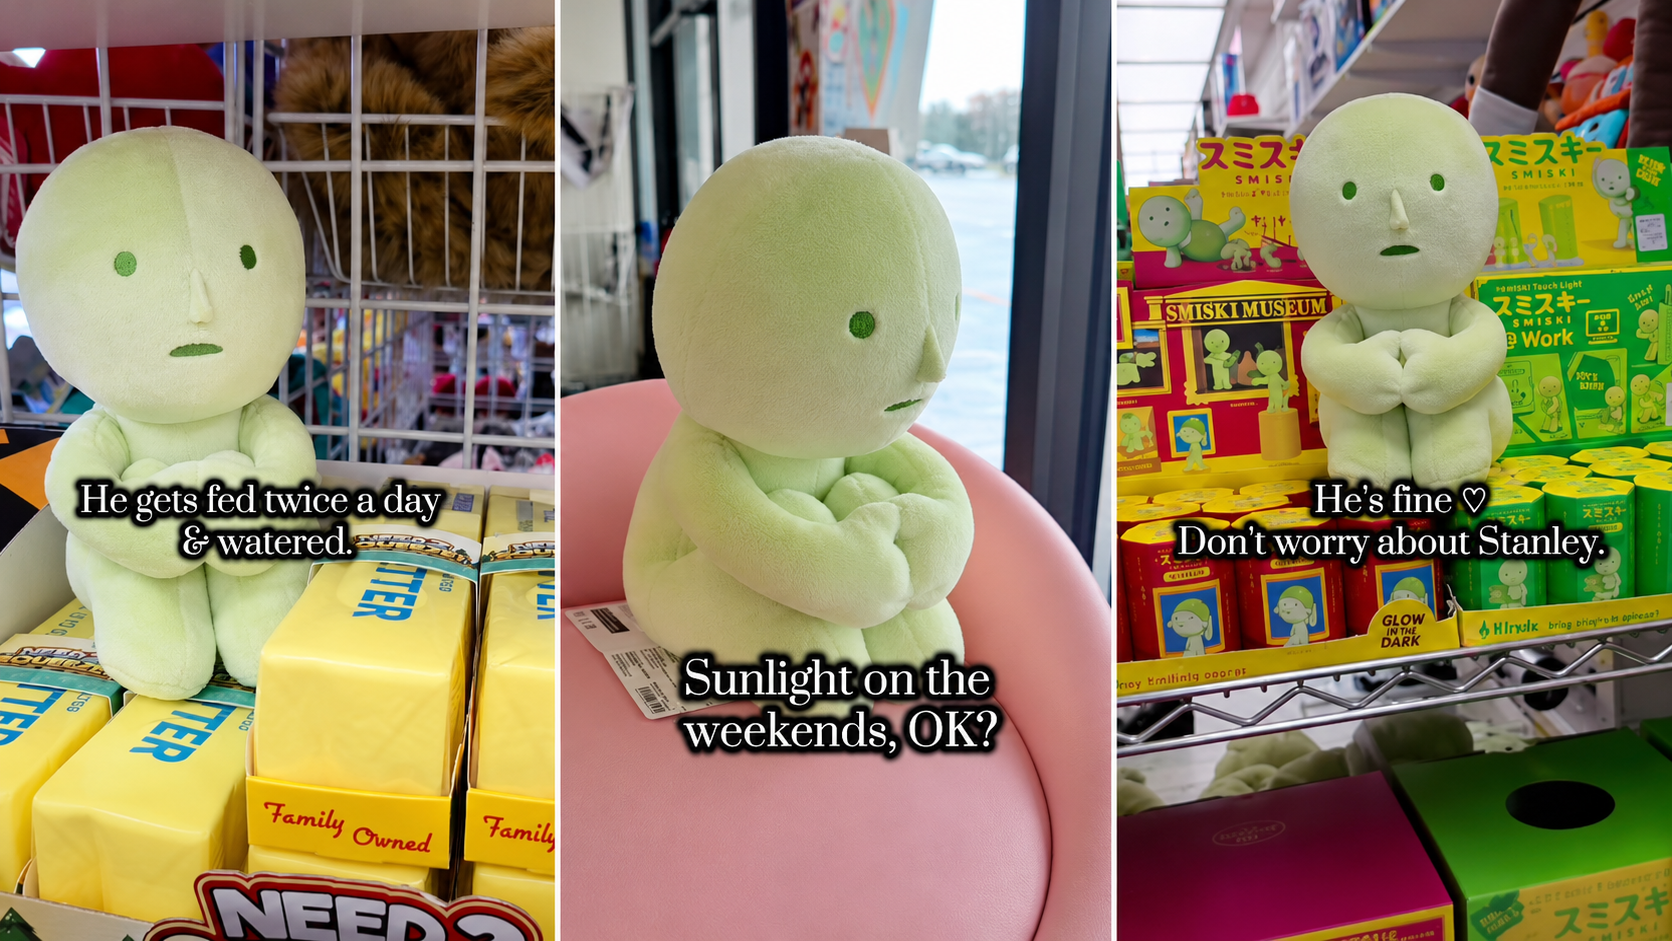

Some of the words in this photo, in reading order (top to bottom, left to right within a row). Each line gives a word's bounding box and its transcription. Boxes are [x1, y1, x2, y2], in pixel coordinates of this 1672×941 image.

[1235, 174, 1292, 186] SMIS
[1511, 168, 1576, 180] SMISKI
[1166, 301, 1239, 322] SMISKI
[1242, 297, 1328, 318] MUSEUM
[1492, 291, 1591, 316] スミスキー
[1513, 315, 1572, 328] SMISKI
[1521, 327, 1574, 349] Work
[352, 562, 429, 622] TTER
[1382, 613, 1426, 627] GLOW
[1386, 627, 1399, 637] IN
[1400, 626, 1418, 636] THE
[1381, 635, 1421, 648] DARK
[263, 801, 345, 839] Family
[353, 826, 433, 853] Owned
